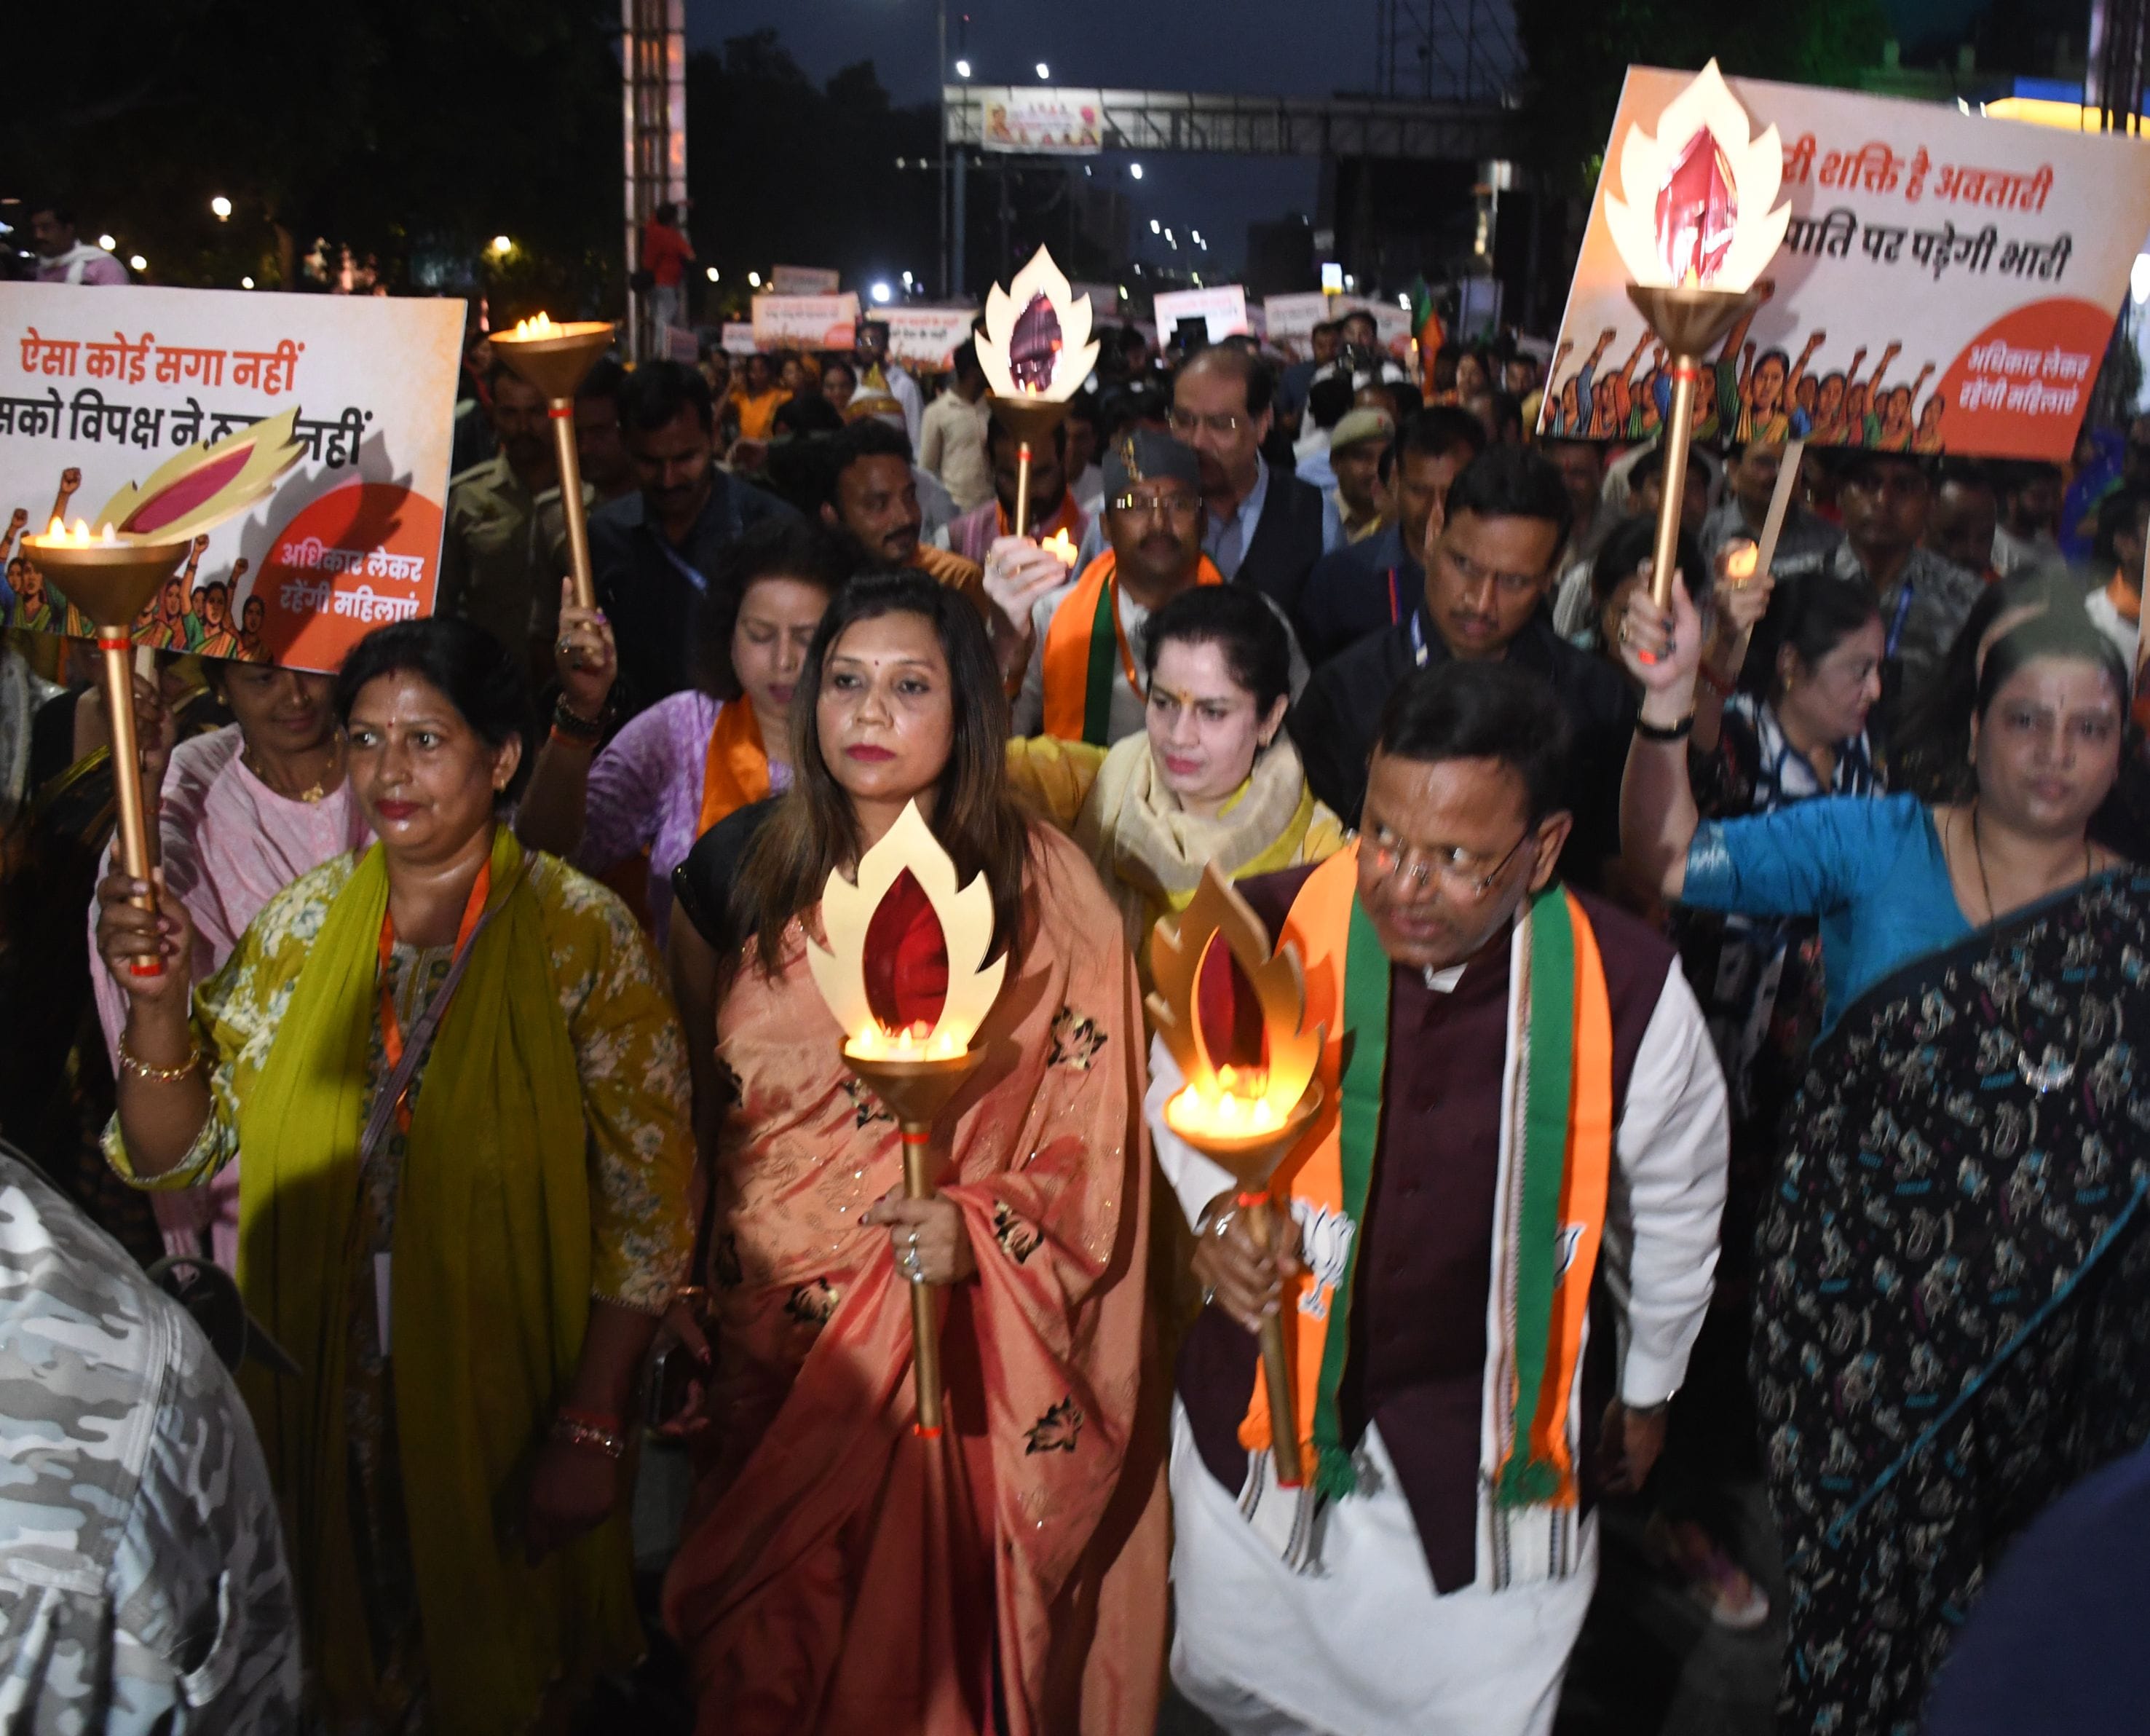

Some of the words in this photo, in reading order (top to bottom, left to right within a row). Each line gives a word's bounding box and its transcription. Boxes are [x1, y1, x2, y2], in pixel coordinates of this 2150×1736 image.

[1782, 130, 1817, 186] री
[1819, 141, 1905, 195] शक्ति
[1905, 143, 1932, 204] है
[1934, 162, 2053, 214] अवतारी
[1862, 223, 1908, 264] पर
[1911, 219, 1997, 283] पड़ेगी
[1999, 231, 2072, 283] भारी
[20, 326, 80, 376] ऐसा
[85, 331, 155, 384] कोई
[155, 347, 226, 386] सगा
[232, 339, 305, 395] नहीं
[69, 387, 165, 450] विपक्ष
[171, 397, 204, 446] ने
[280, 536, 365, 575] अधिकार
[367, 545, 424, 582] लेकर
[280, 578, 331, 615] रहेंगी
[334, 585, 419, 624] महिलाएं
